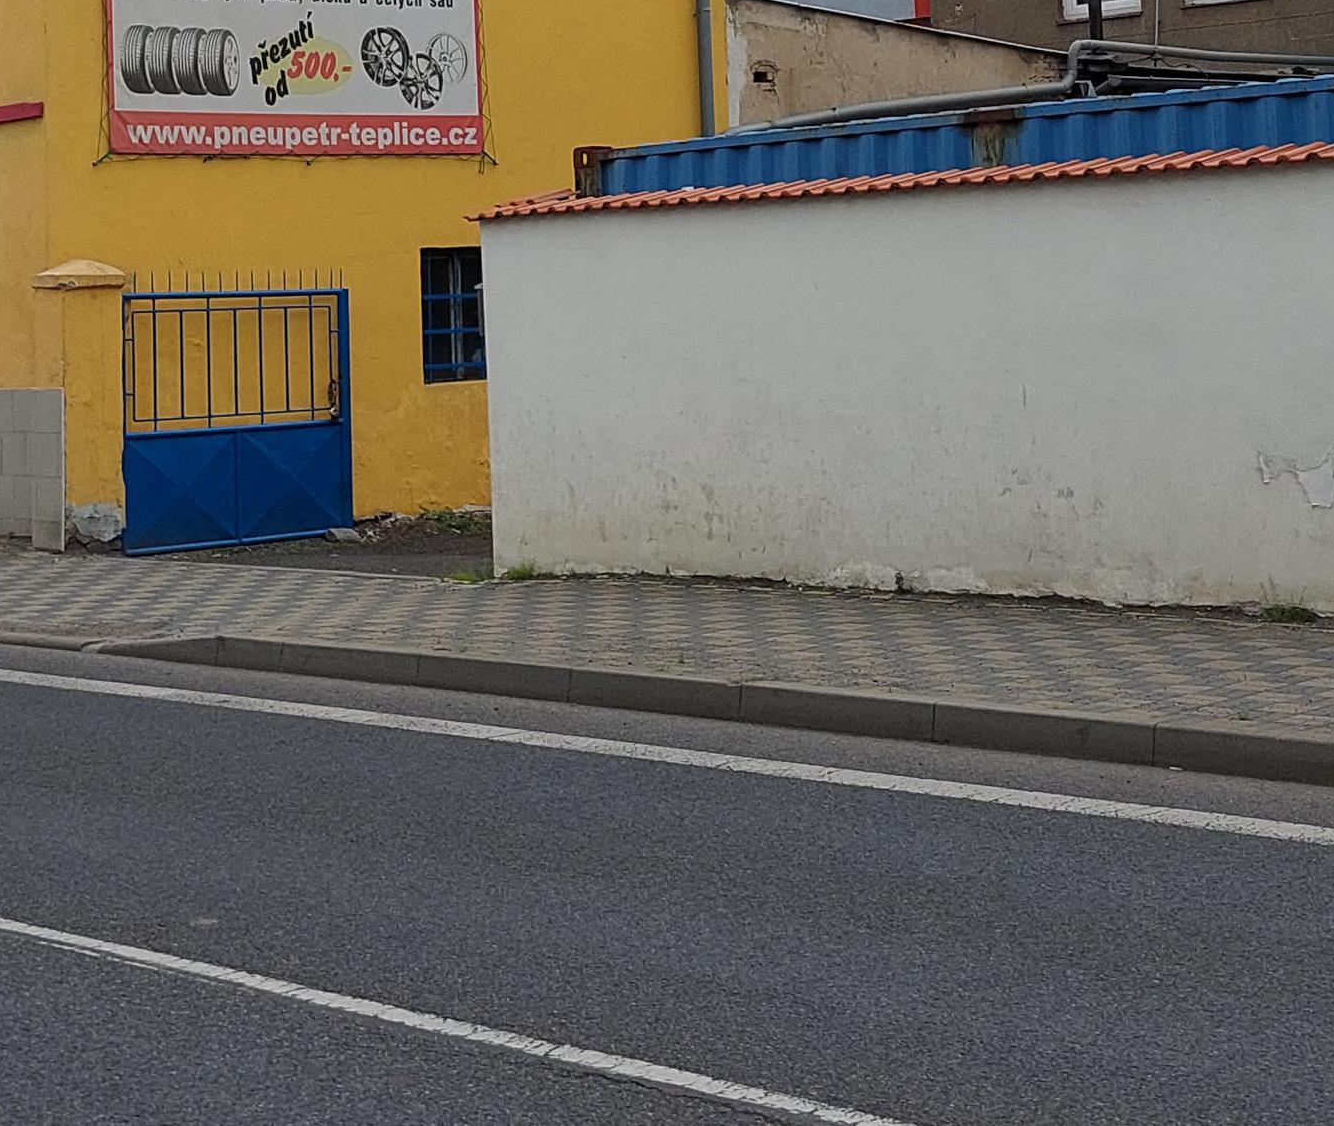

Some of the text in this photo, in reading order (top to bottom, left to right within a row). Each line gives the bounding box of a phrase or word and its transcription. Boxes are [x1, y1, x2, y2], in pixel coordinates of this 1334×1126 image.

[249, 11, 314, 85] přezutí
[265, 69, 289, 106] od
[126, 121, 478, 150] www.pneupetr-teplice.cz
